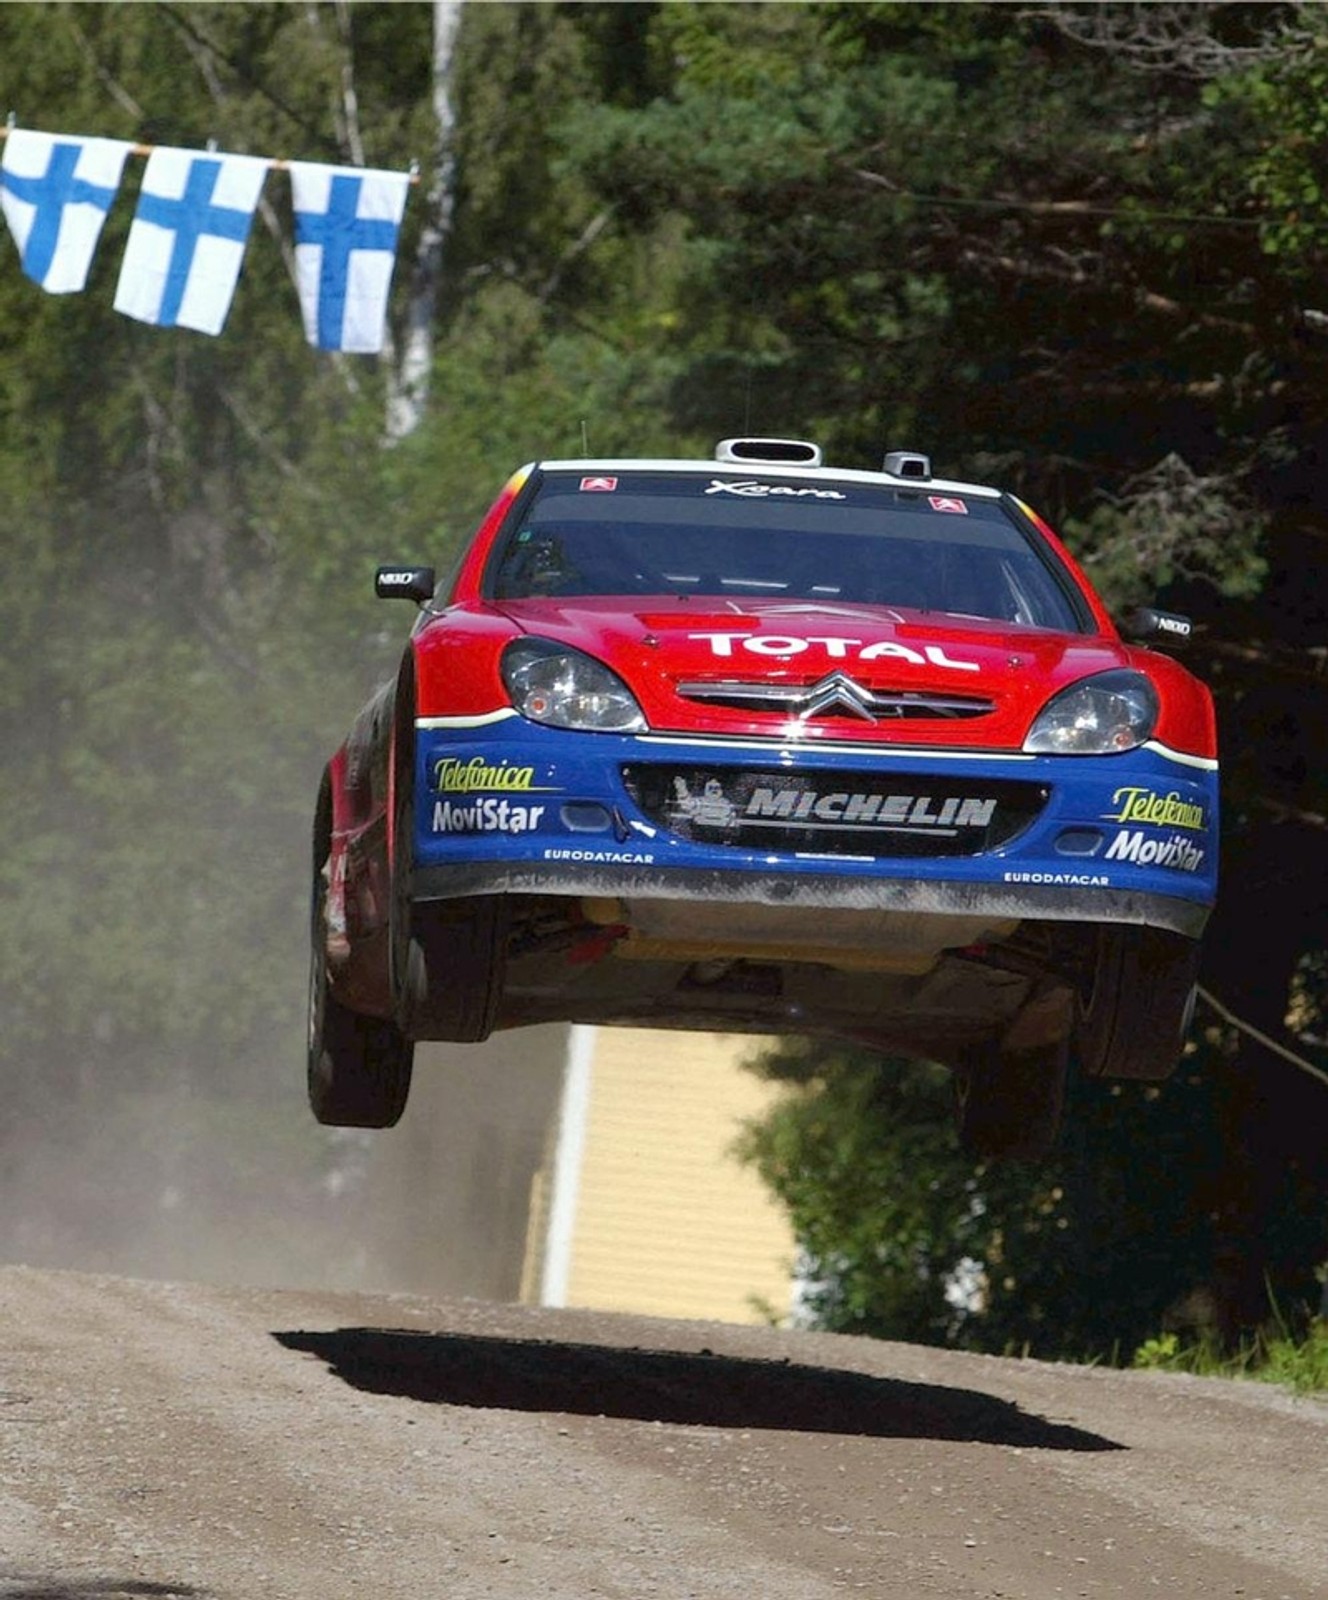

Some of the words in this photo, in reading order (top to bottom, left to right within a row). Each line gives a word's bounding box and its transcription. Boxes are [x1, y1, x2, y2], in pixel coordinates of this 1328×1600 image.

[688, 633, 980, 672] TOTAL
[432, 798, 545, 833] MoviStar
[746, 788, 997, 827] MICHELIN
[544, 849, 654, 864] EURODATACAR
[1104, 830, 1204, 871] MoviStar
[1004, 872, 1109, 886] EURODATACAR
